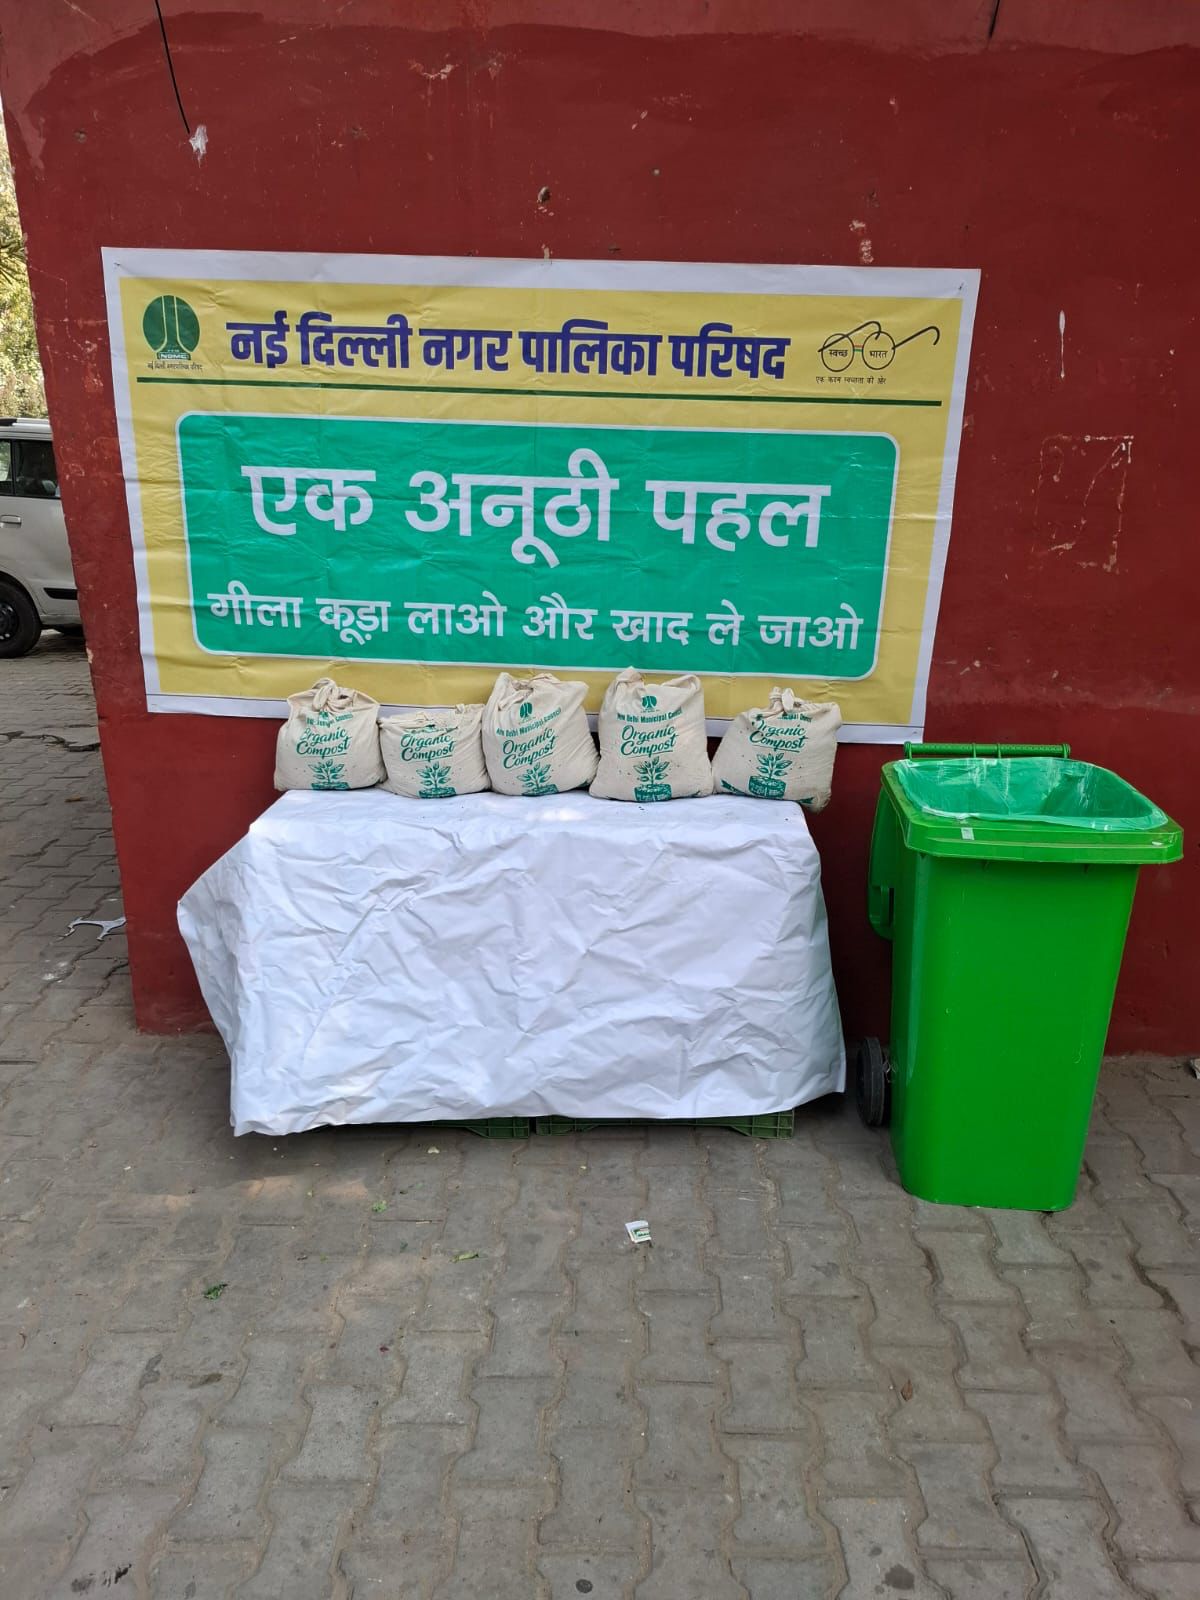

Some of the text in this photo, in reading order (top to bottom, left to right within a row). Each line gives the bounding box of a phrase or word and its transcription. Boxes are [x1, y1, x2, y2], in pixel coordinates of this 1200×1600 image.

[226, 311, 790, 378] नई दिल्ली नगर पालिका परिषद
[869, 350, 888, 359] भारत
[241, 448, 831, 568] एक अनूठी पहल
[207, 581, 864, 650] गीला कूड़ा लाओ और खाद ले जाओ
[296, 736, 352, 759] Compost
[502, 727, 555, 757] Organic
[620, 733, 679, 758] Compost
[621, 724, 676, 746] Organic
[749, 729, 808, 752] Compost
[401, 740, 456, 763] Compost
[503, 735, 559, 769] Compost
